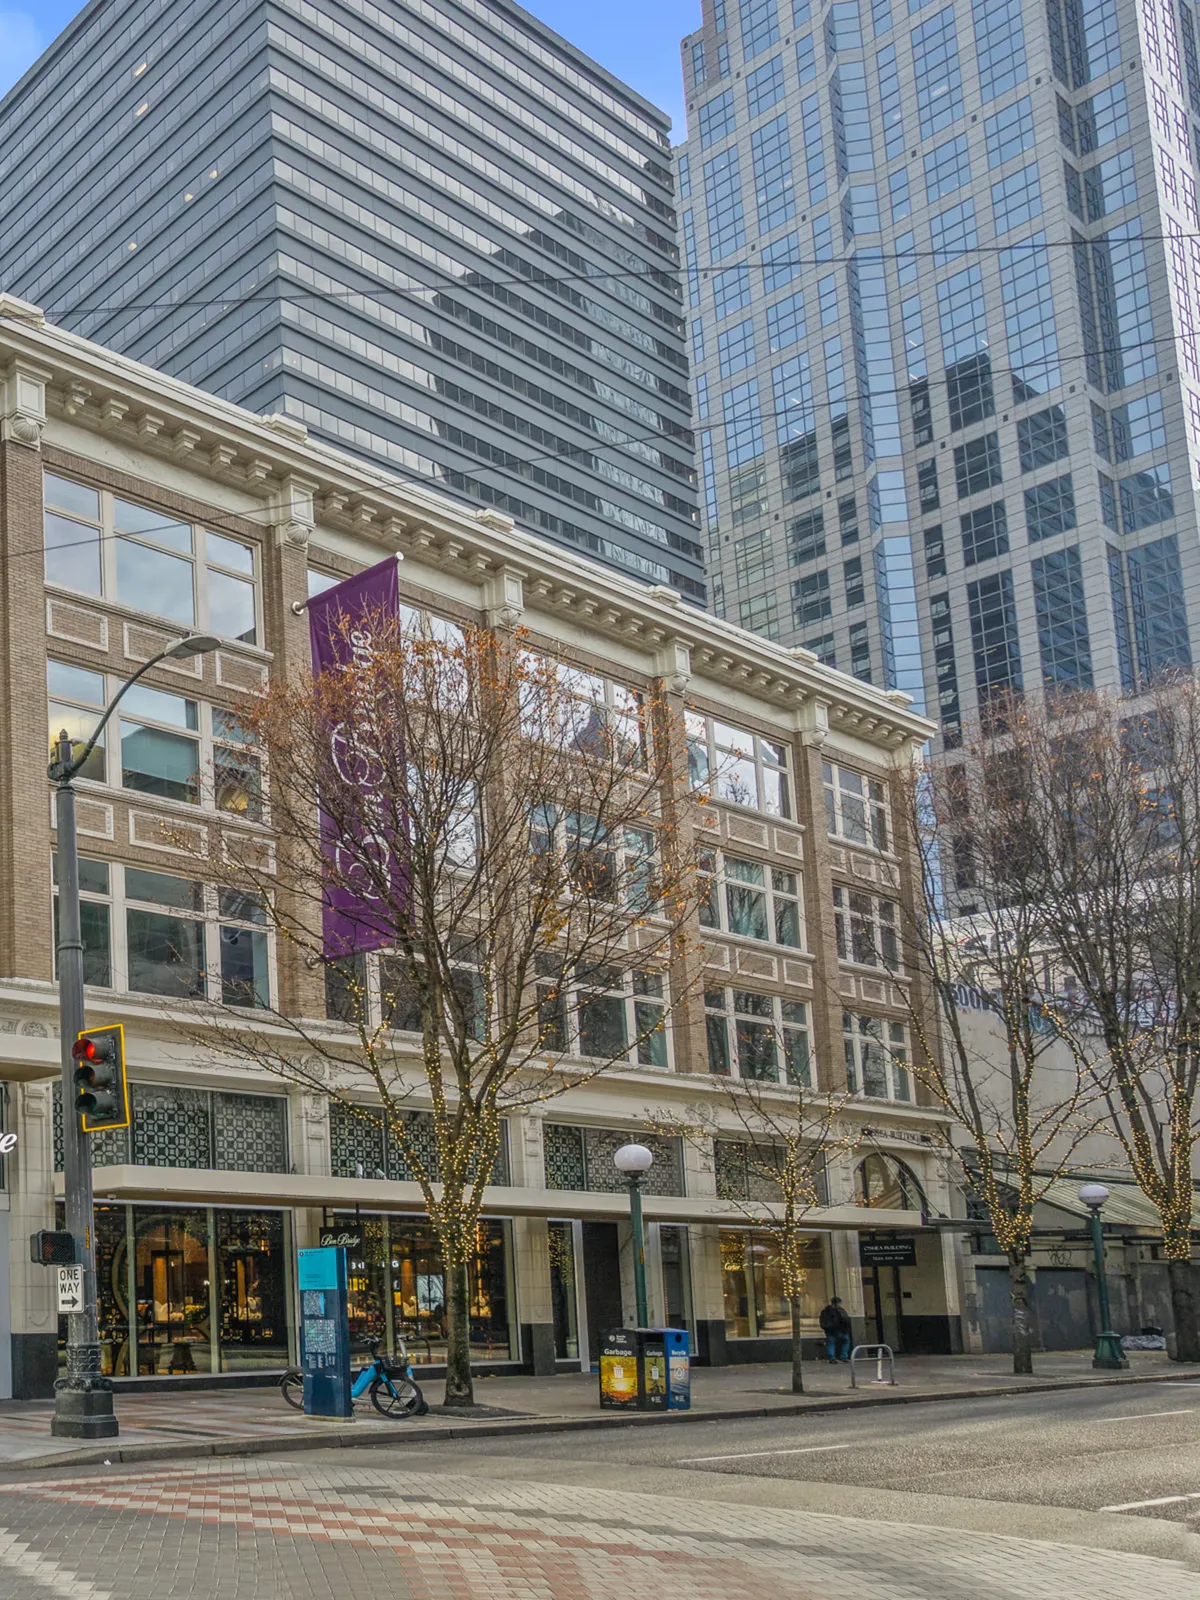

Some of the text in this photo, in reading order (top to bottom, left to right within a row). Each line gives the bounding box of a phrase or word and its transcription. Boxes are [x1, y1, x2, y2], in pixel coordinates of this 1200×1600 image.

[320, 1232, 361, 1247] Ben Bridge
[60, 1269, 79, 1281] ONE
[60, 1282, 80, 1294] WAY
[604, 1348, 632, 1356] Garbage
